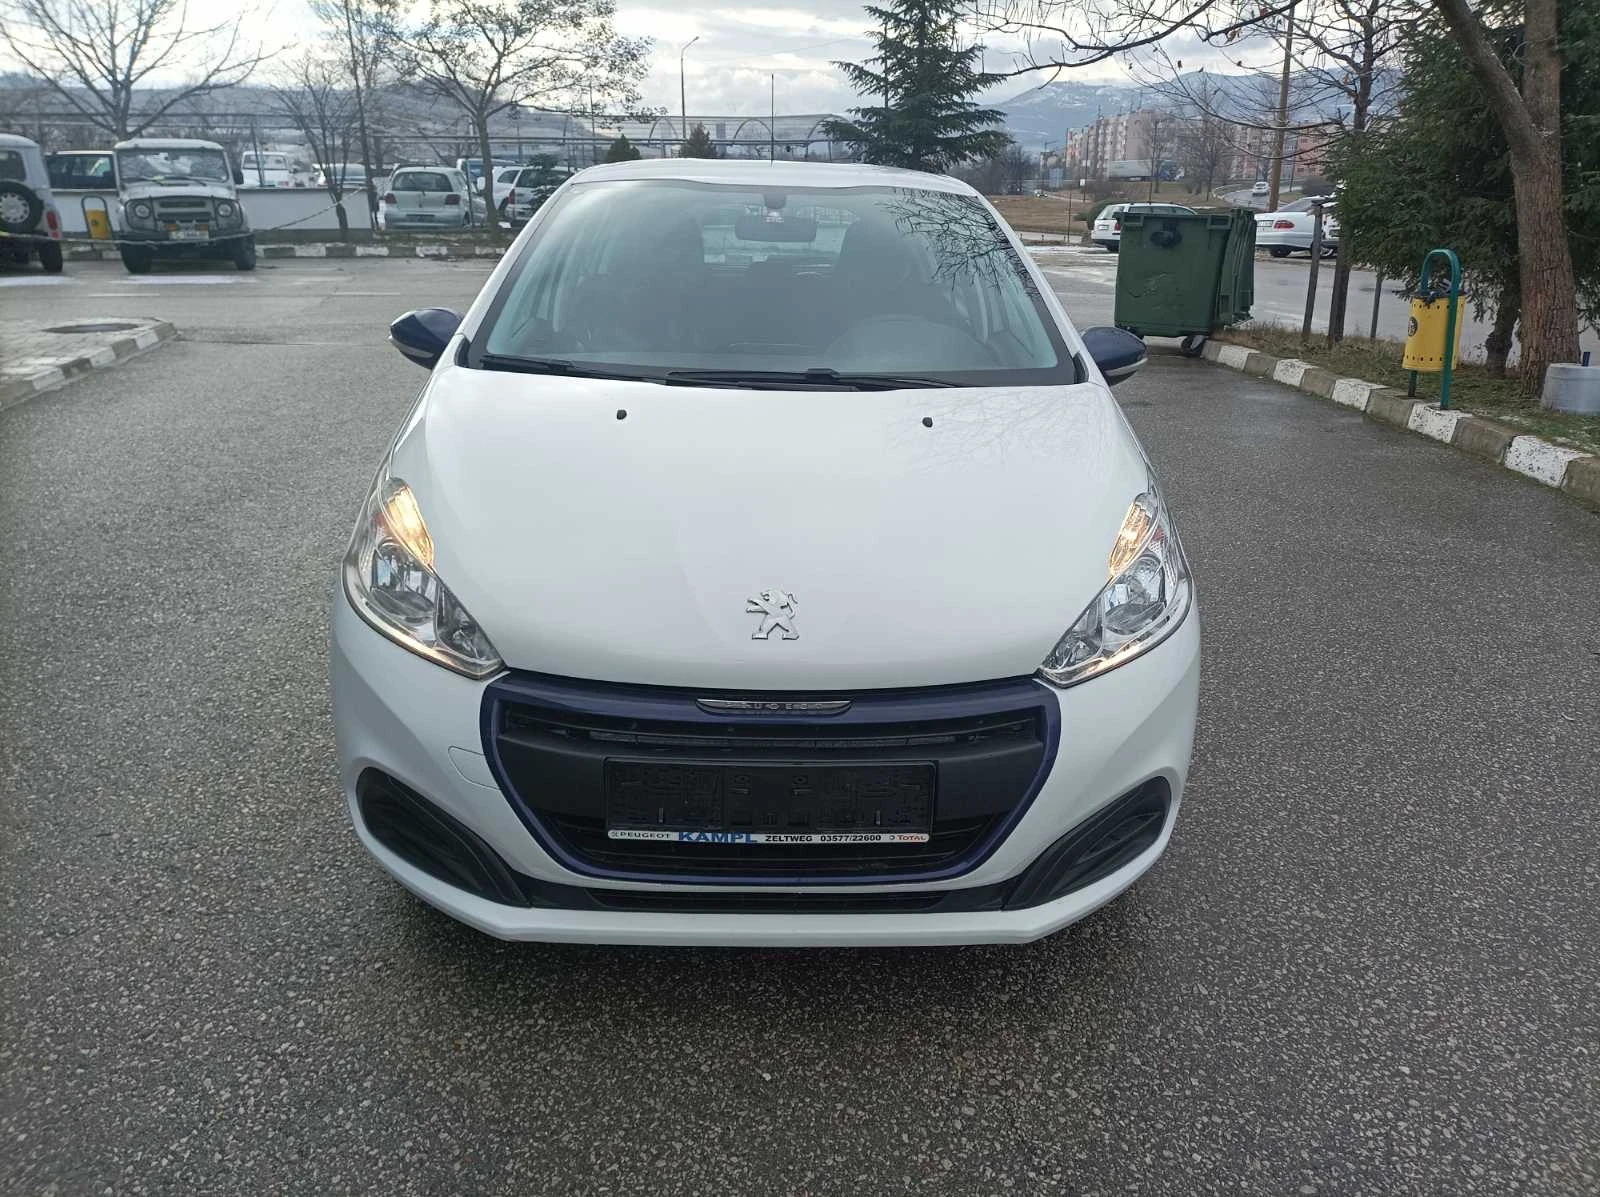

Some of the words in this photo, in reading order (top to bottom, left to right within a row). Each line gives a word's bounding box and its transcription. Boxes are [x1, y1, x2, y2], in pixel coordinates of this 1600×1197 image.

[619, 831, 670, 839] PEUGEOT
[678, 831, 758, 843] KAMPL
[765, 834, 813, 842] ZELTWEG
